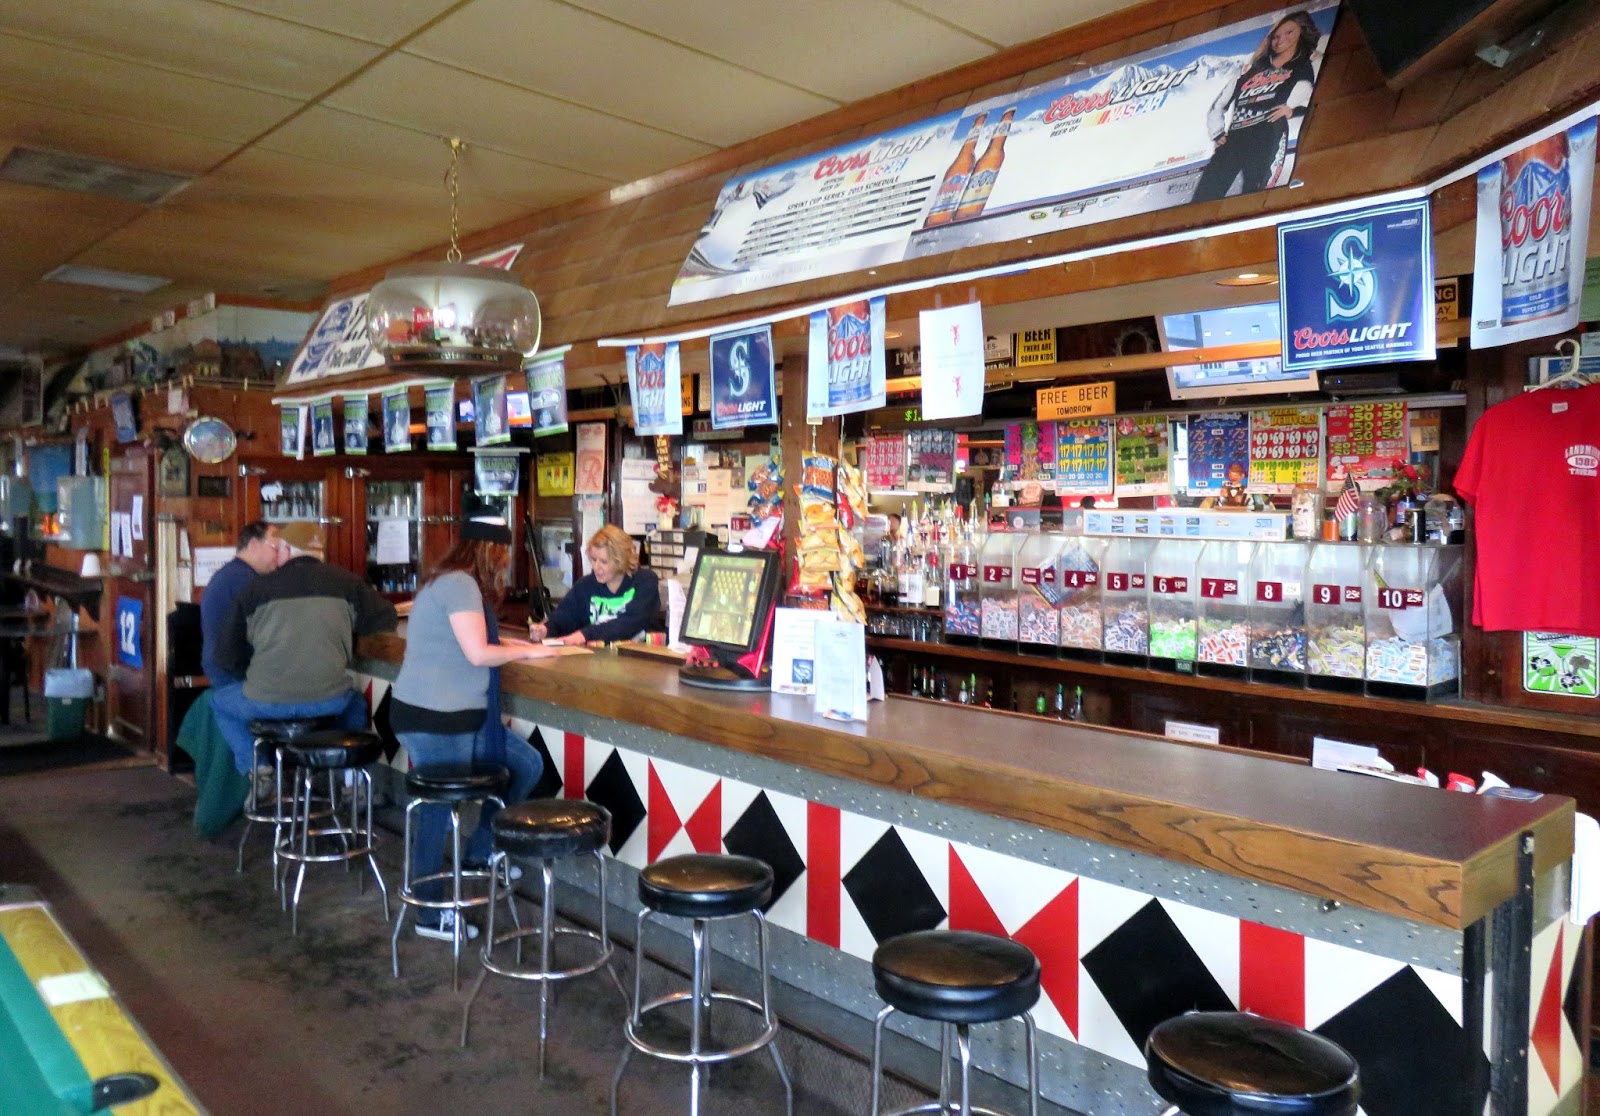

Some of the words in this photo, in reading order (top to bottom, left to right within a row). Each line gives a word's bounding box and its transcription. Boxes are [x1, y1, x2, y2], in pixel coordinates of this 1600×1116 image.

[1043, 89, 1112, 124] Coors
[1110, 60, 1200, 105] LIGHT
[1238, 81, 1284, 99] LIGHT
[814, 151, 872, 180] Coors
[869, 134, 935, 165] LIGHT
[787, 201, 808, 211] SPRINT
[823, 192, 845, 201] SERIES
[864, 176, 901, 192] SCHEDULE
[1500, 188, 1571, 252] Coor
[1502, 233, 1571, 287] LIGHT
[1293, 327, 1350, 350] Coors
[1349, 322, 1412, 343] LIGHT
[828, 359, 871, 385] LIGHT
[1040, 390, 1068, 405] FREE
[1078, 386, 1108, 401] BEER
[738, 401, 767, 412] LIGHT
[1056, 405, 1093, 416] TOMORROW
[955, 566, 960, 578] 1
[989, 568, 996, 581] 2
[1070, 573, 1078, 586] 4
[1113, 575, 1120, 589] 5
[1159, 578, 1167, 593] 6
[1208, 582, 1216, 596] 7
[1264, 584, 1273, 599] 8
[1320, 586, 1331, 603] 9
[1383, 590, 1403, 608] 10
